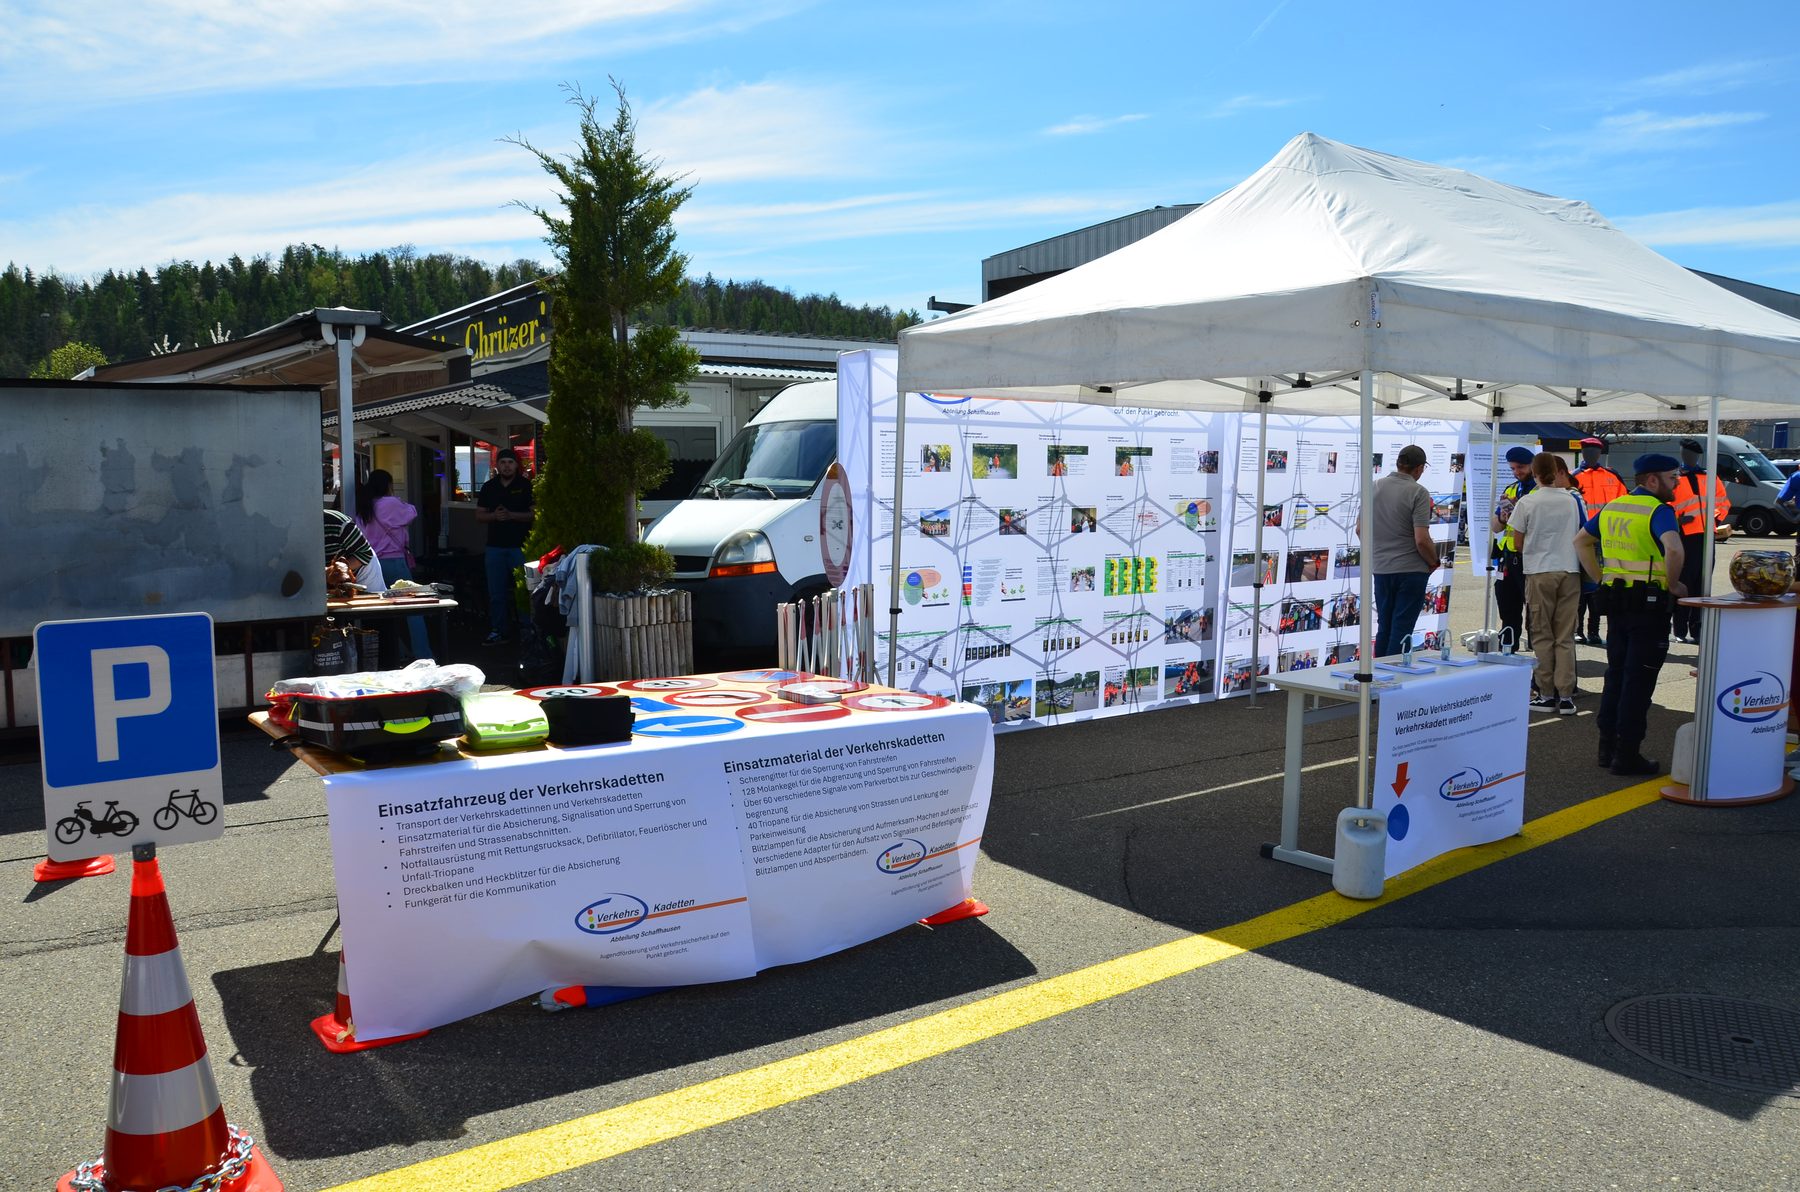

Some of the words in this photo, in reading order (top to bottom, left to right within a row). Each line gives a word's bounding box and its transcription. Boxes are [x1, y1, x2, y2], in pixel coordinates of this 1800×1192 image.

[465, 301, 546, 361] Chrüzer!
[1608, 516, 1632, 538] VK
[91, 645, 172, 762] P
[1397, 710, 1417, 721] Willst
[1418, 708, 1428, 717] Du
[1430, 695, 1479, 715] Verkehrskadettin
[1480, 692, 1493, 702] oder
[1744, 694, 1780, 706] Verkehrs
[1394, 718, 1448, 736] Verkehrskadett
[1448, 711, 1473, 724] werden?
[724, 749, 822, 774] Einsatzmaterial
[824, 748, 844, 759] der
[846, 733, 945, 755] Verkehrskadetten
[739, 771, 788, 784] Scherengitter
[790, 768, 799, 777] für
[801, 766, 811, 775] die
[813, 763, 844, 775] Sperrung
[858, 753, 898, 766] Fahrstreifen
[742, 786, 756, 796] 128
[757, 779, 798, 794] Molankegel
[799, 777, 809, 786] für
[810, 775, 821, 785] die
[822, 770, 862, 783] Abgrenzung
[864, 766, 876, 776] und
[877, 764, 907, 776] Sperrung
[920, 756, 956, 768] Fahrstreifen
[378, 792, 506, 817] Einsatzfahrzeug
[509, 787, 534, 800] der
[537, 772, 664, 797] Verkehrskadetten
[743, 797, 762, 807] Über
[763, 795, 772, 804] 60
[773, 789, 821, 803] verschiedene
[822, 784, 847, 796] Signale
[848, 783, 863, 791] vom
[864, 776, 899, 788] Parkverbot
[900, 774, 910, 783] bis
[921, 764, 976, 779] Geschwindigkeits-
[1453, 781, 1479, 790] Verkehrs
[397, 818, 441, 830] Transport
[443, 816, 458, 824] der
[460, 804, 551, 822] Verkehrskadettinnen
[553, 800, 570, 810] und
[570, 792, 643, 808] Verkehrskadetten
[398, 826, 471, 844] Einsatzmaterial
[472, 825, 485, 834] für
[487, 822, 501, 832] die
[502, 816, 560, 830] Absicherung,
[561, 808, 615, 822] Signalisation
[617, 804, 632, 814] und
[634, 800, 671, 813] Sperrung
[672, 798, 686, 806] von
[745, 805, 788, 819] begrenzung
[748, 820, 758, 829] 40
[758, 817, 790, 828] Triopane
[791, 814, 801, 823] für
[802, 812, 813, 821] die
[815, 806, 858, 819] Absicherung
[870, 798, 900, 809] Strassen
[900, 794, 912, 804] und
[913, 791, 938, 802] Lenkung
[939, 788, 949, 797] der
[400, 843, 456, 857] Fahrstreifen
[458, 839, 476, 849] und
[478, 828, 572, 847] Strassenabschnitten.
[401, 852, 486, 870] Notfallausrüstung
[488, 848, 502, 858] mit
[504, 836, 585, 855] Rettungsrucksack,
[586, 830, 638, 844] Defibrillator,
[639, 821, 691, 836] Feuerlöscher
[692, 817, 707, 827] und
[750, 826, 806, 841] Parkeinweisung
[752, 839, 795, 853] Blitzlampen
[796, 836, 806, 845] für
[807, 834, 818, 843] die
[819, 828, 861, 841] Absicherung
[862, 823, 874, 833] und
[875, 811, 940, 831] Aufmerksam-Machen
[940, 806, 949, 816] auf
[950, 806, 960, 814] den
[754, 850, 802, 865] Verschiedene
[803, 844, 831, 856] Adapter
[832, 841, 841, 850] für
[842, 840, 855, 848] den
[856, 834, 879, 846] Aufsatz
[880, 831, 892, 840] von
[893, 825, 919, 838] Signalen
[919, 821, 930, 831] und
[756, 862, 798, 876] Blitzlampen
[799, 857, 813, 868] und
[814, 849, 869, 865] Absperrbändern.
[892, 852, 920, 863] Verkehrs
[402, 867, 474, 883] Unfall-Triopane
[404, 881, 463, 896] Dreckbalken
[466, 876, 484, 887] und
[485, 871, 536, 884] Heckblitzer
[538, 867, 550, 877] für
[552, 865, 566, 874] die
[567, 857, 620, 872] Absicherung
[405, 895, 452, 909] Funkgerät
[454, 892, 467, 902] für
[469, 890, 484, 899] die
[485, 880, 557, 897] Kommunikation
[597, 908, 640, 922] Verkehrs
[653, 899, 695, 912] Kadetten
[610, 932, 639, 943] Abteilung
[641, 925, 681, 937] Schaffhausen
[660, 936, 710, 950] Verkehrssicherheit
